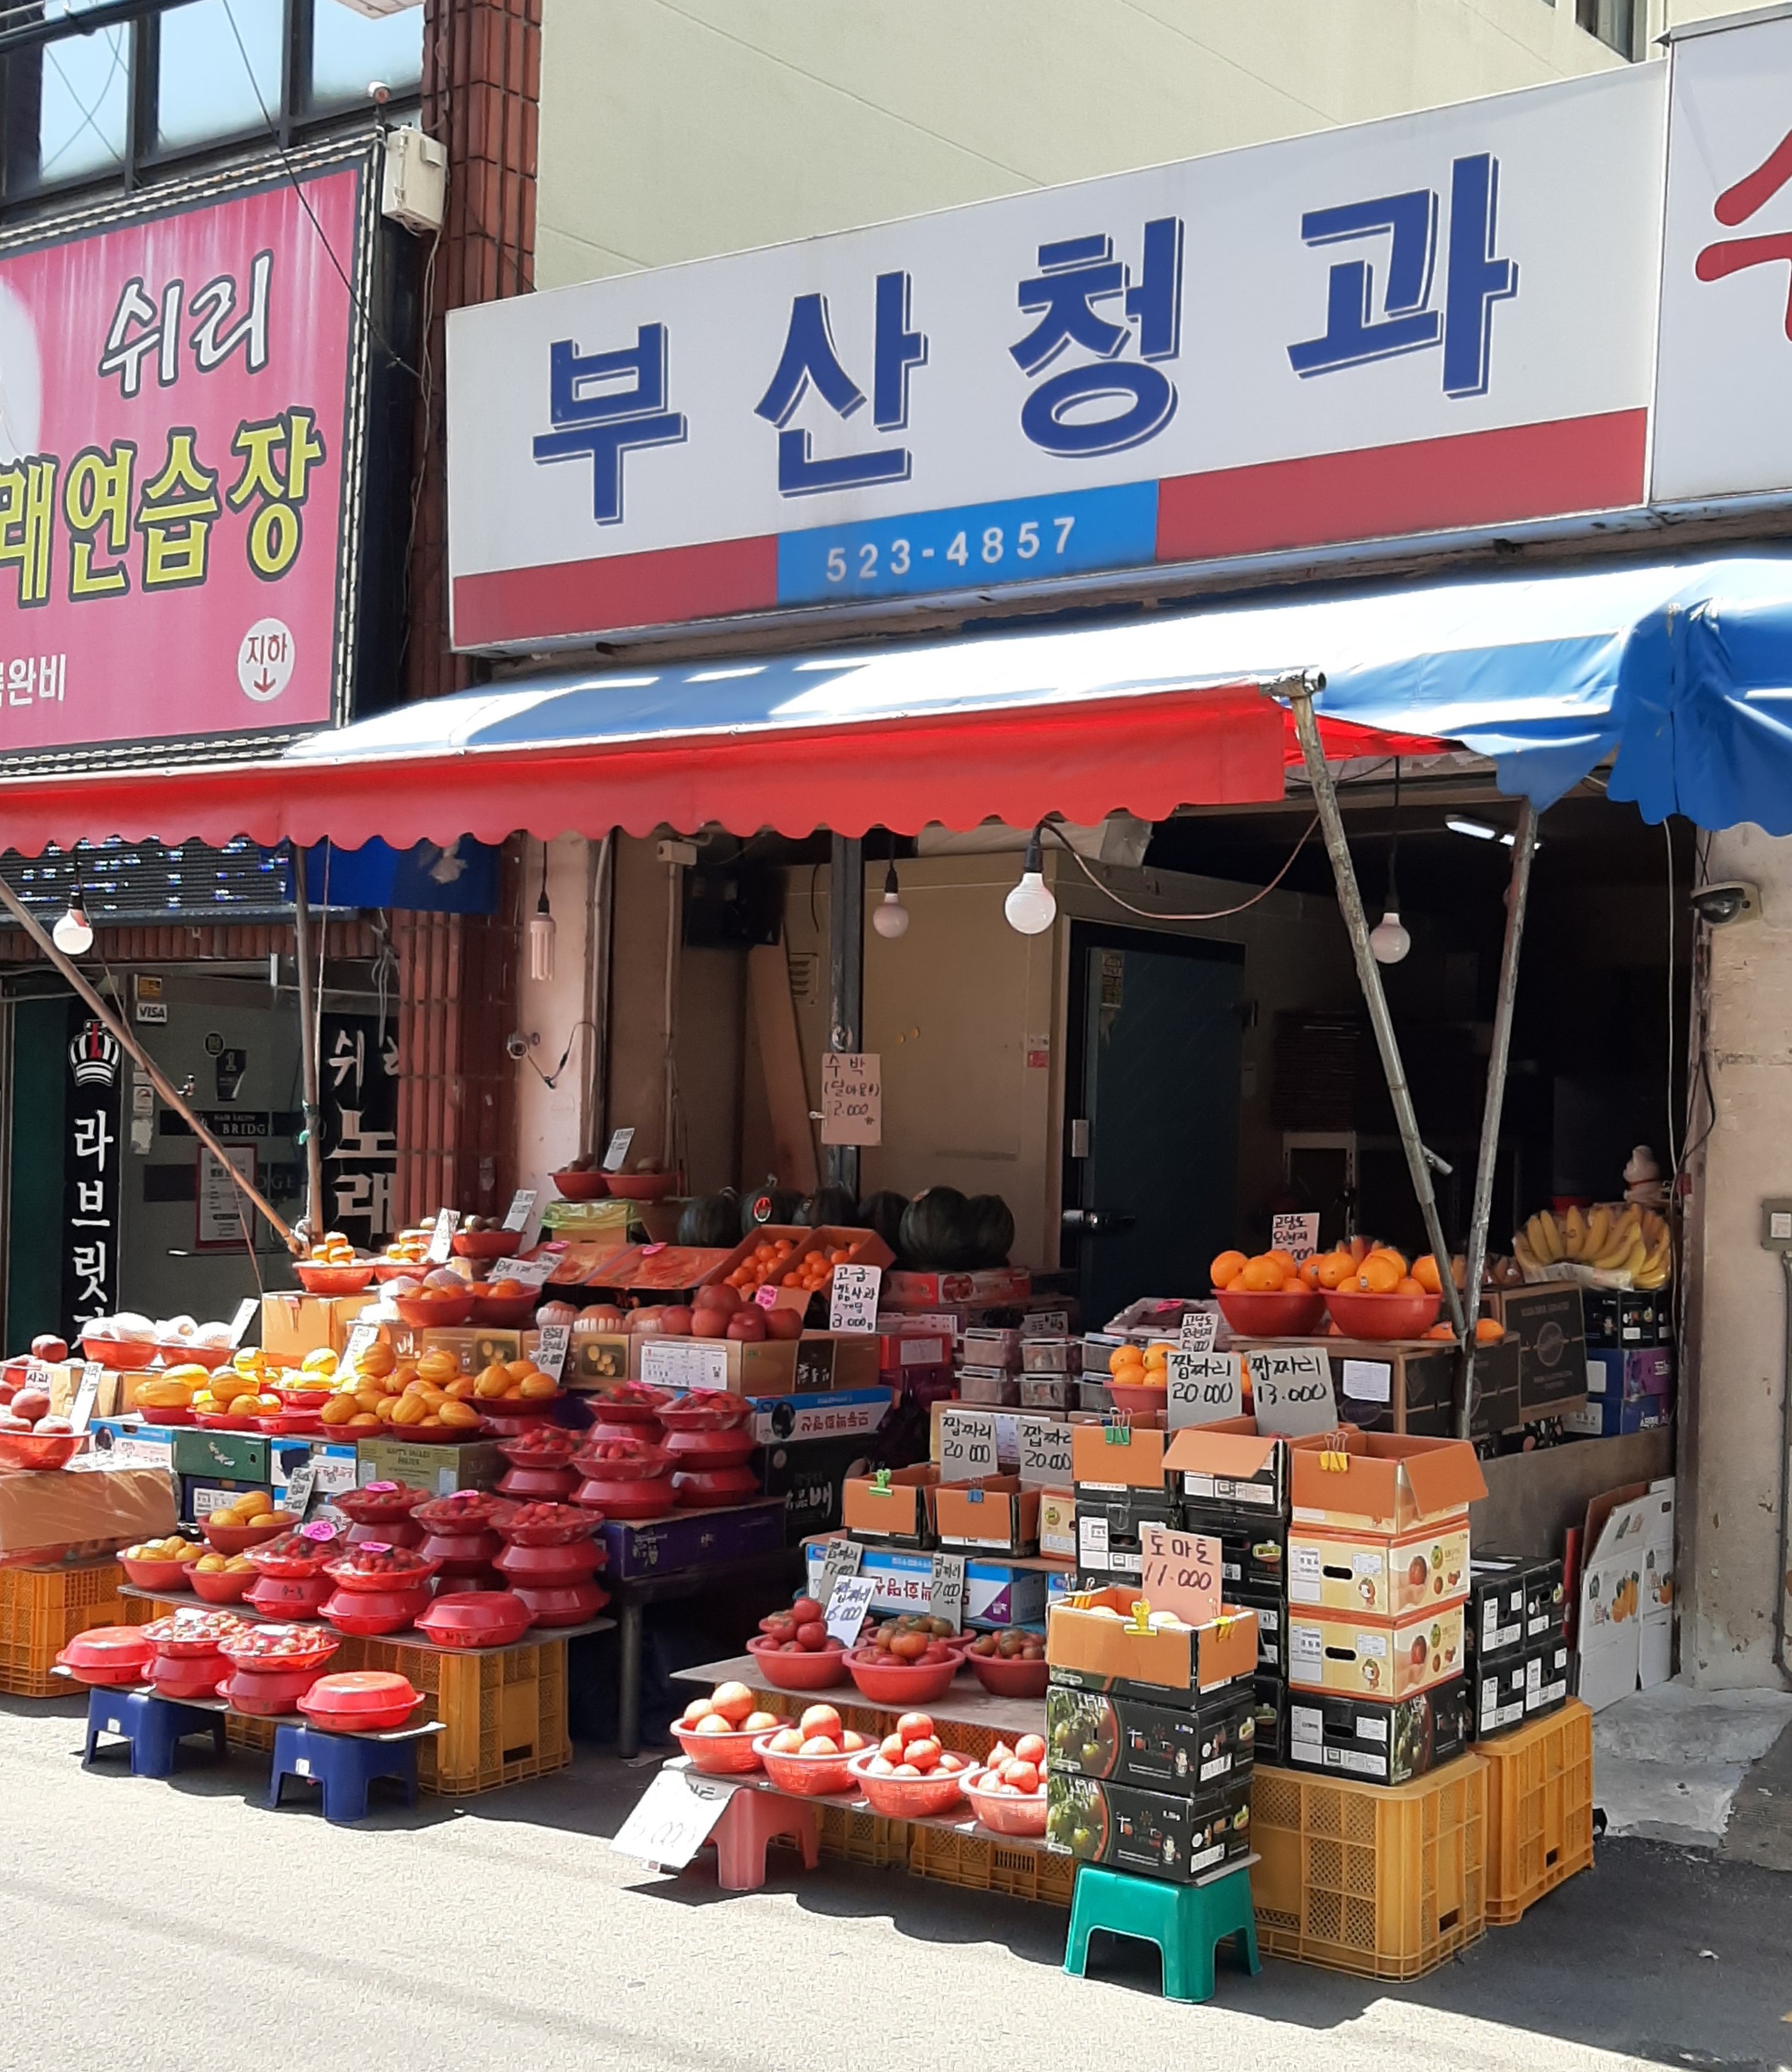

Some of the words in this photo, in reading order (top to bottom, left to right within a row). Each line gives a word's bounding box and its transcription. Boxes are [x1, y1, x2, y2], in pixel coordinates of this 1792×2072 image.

[98, 249, 274, 399] 쉬리
[533, 150, 1519, 526] 부산청과
[826, 516, 1075, 582] 523-4857
[246, 632, 288, 665] 지하
[0, 653, 67, 707] 완비
[138, 1004, 165, 1019] VISA
[836, 1267, 871, 1283] 고급
[1258, 1382, 1327, 1405] 13.000
[1150, 1529, 1214, 1566] 토마토
[1144, 1561, 1212, 1591] 11.000
